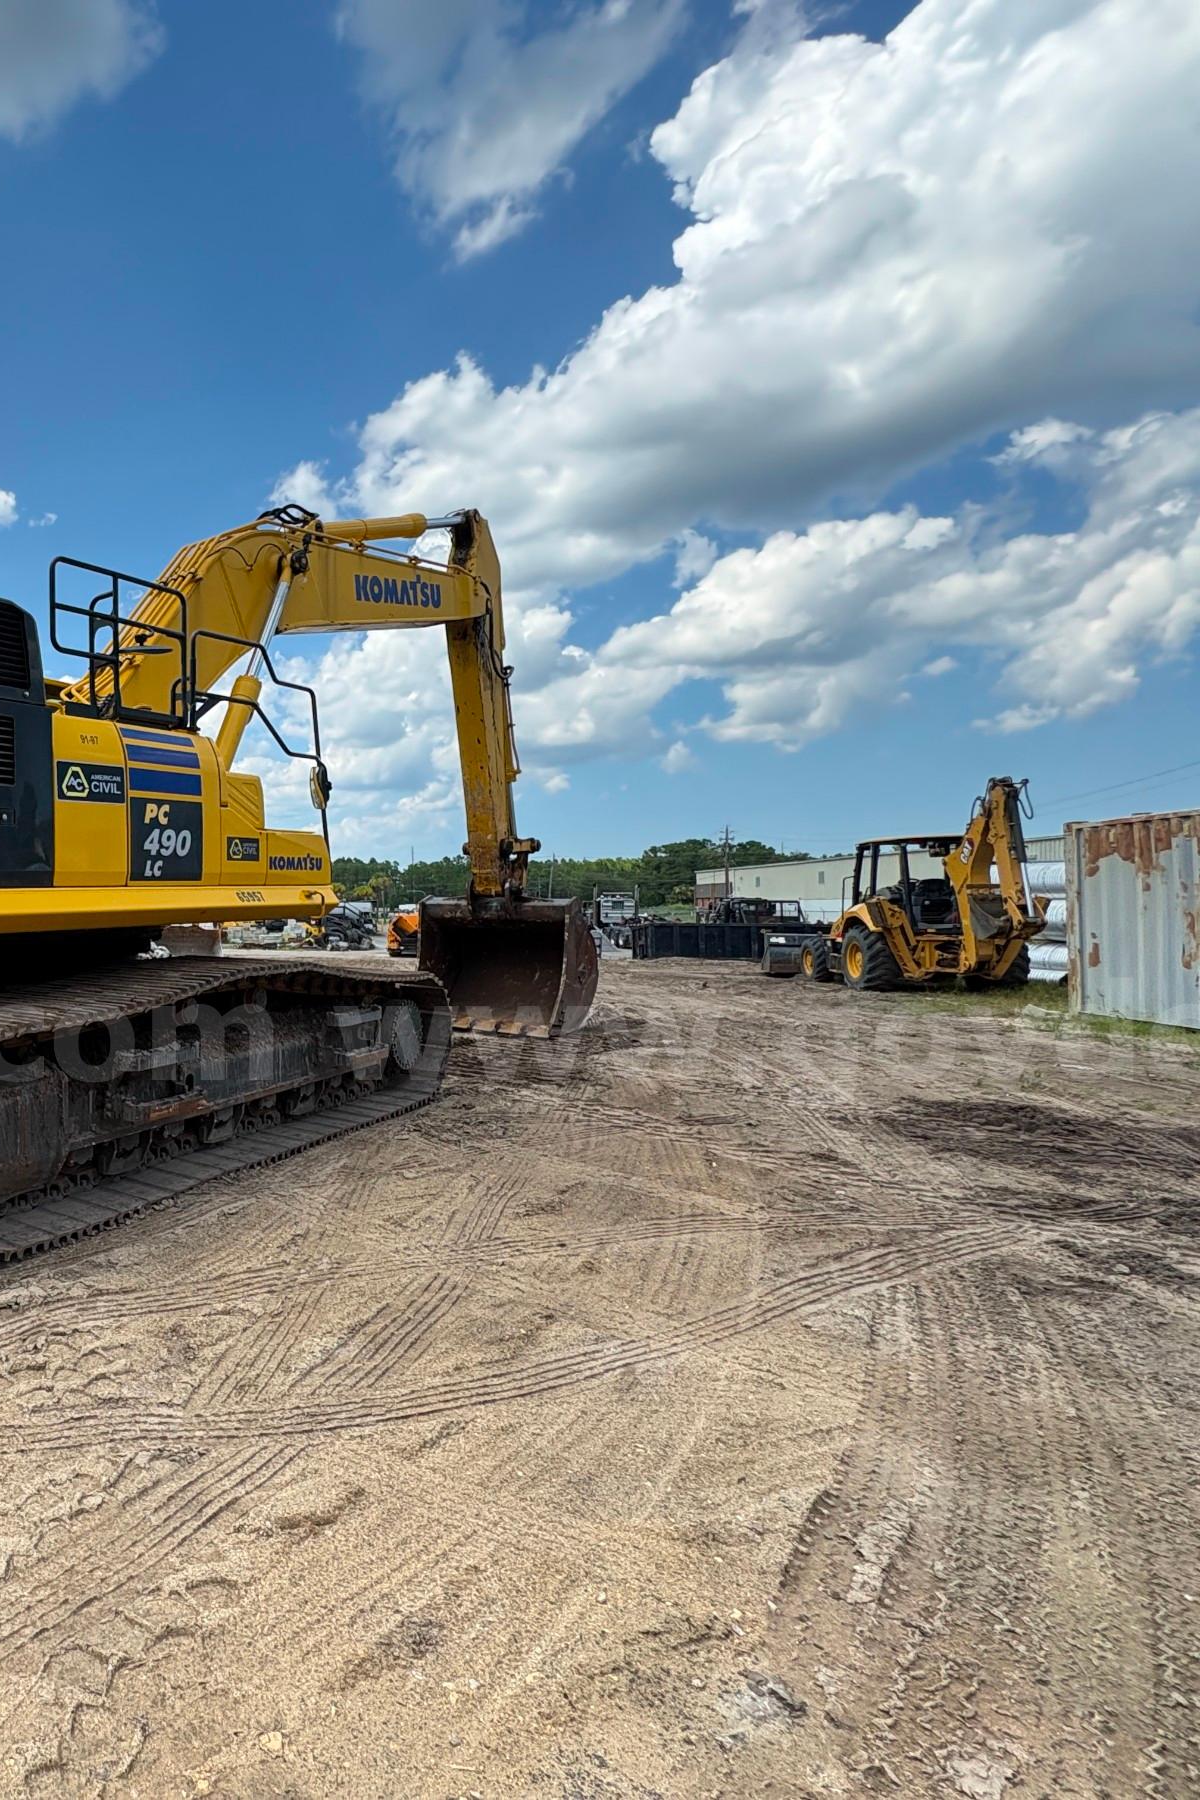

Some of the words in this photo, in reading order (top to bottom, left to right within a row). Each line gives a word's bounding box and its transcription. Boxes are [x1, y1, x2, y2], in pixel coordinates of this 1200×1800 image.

[354, 574, 442, 608] KOMATSU
[90, 774, 121, 782] AMERICAN
[91, 781, 122, 794] CIVIL
[144, 803, 170, 825] PC
[143, 828, 192, 857] 490
[960, 840, 972, 864] CAT
[144, 860, 163, 877] LC
[269, 853, 322, 871] KOMATSU
